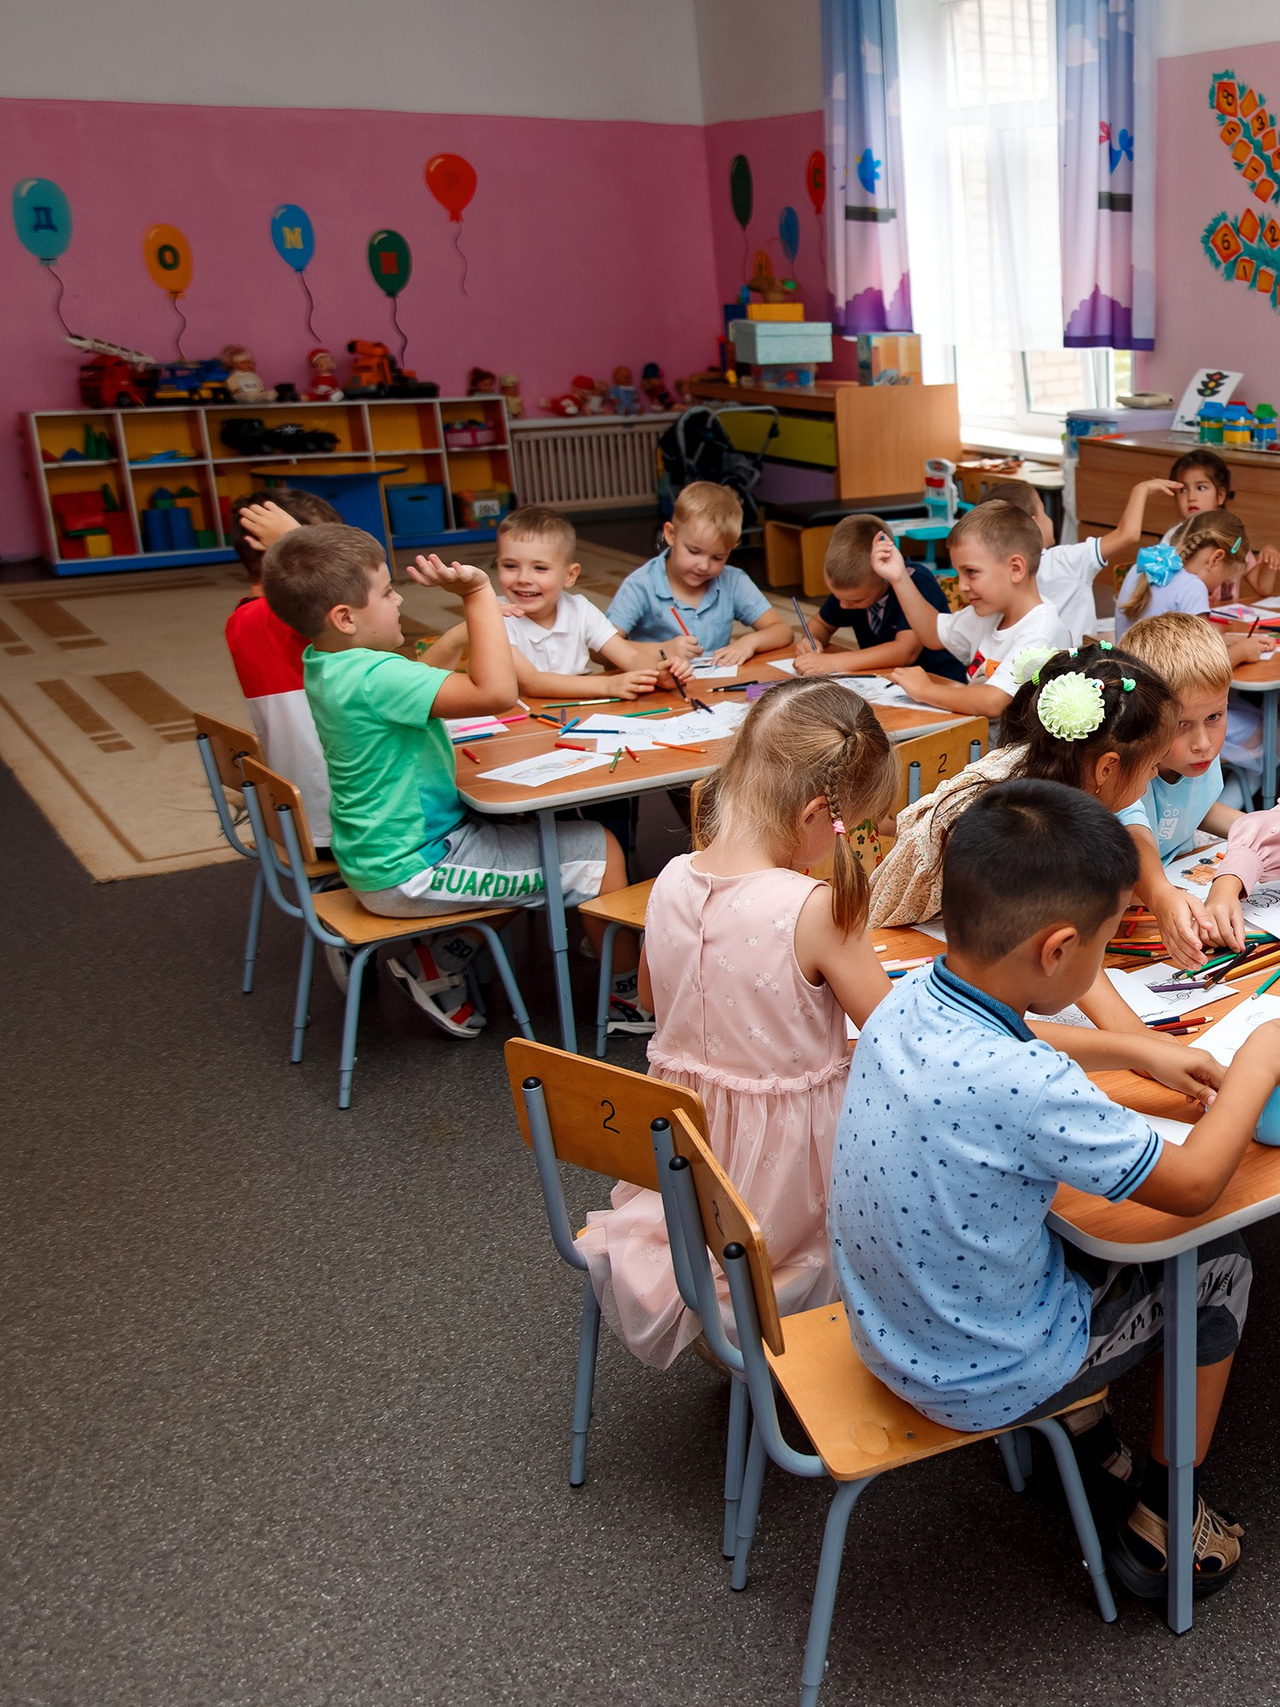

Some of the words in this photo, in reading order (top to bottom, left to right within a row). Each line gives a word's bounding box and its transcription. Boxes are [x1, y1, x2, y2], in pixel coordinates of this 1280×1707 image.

[1222, 90, 1235, 106] 8
[1256, 115, 1265, 131] 3
[1222, 232, 1231, 250] 6
[1269, 226, 1279, 243] 2
[937, 753, 949, 774] 2
[600, 1099, 621, 1134] 2
[712, 1200, 725, 1237] 2
